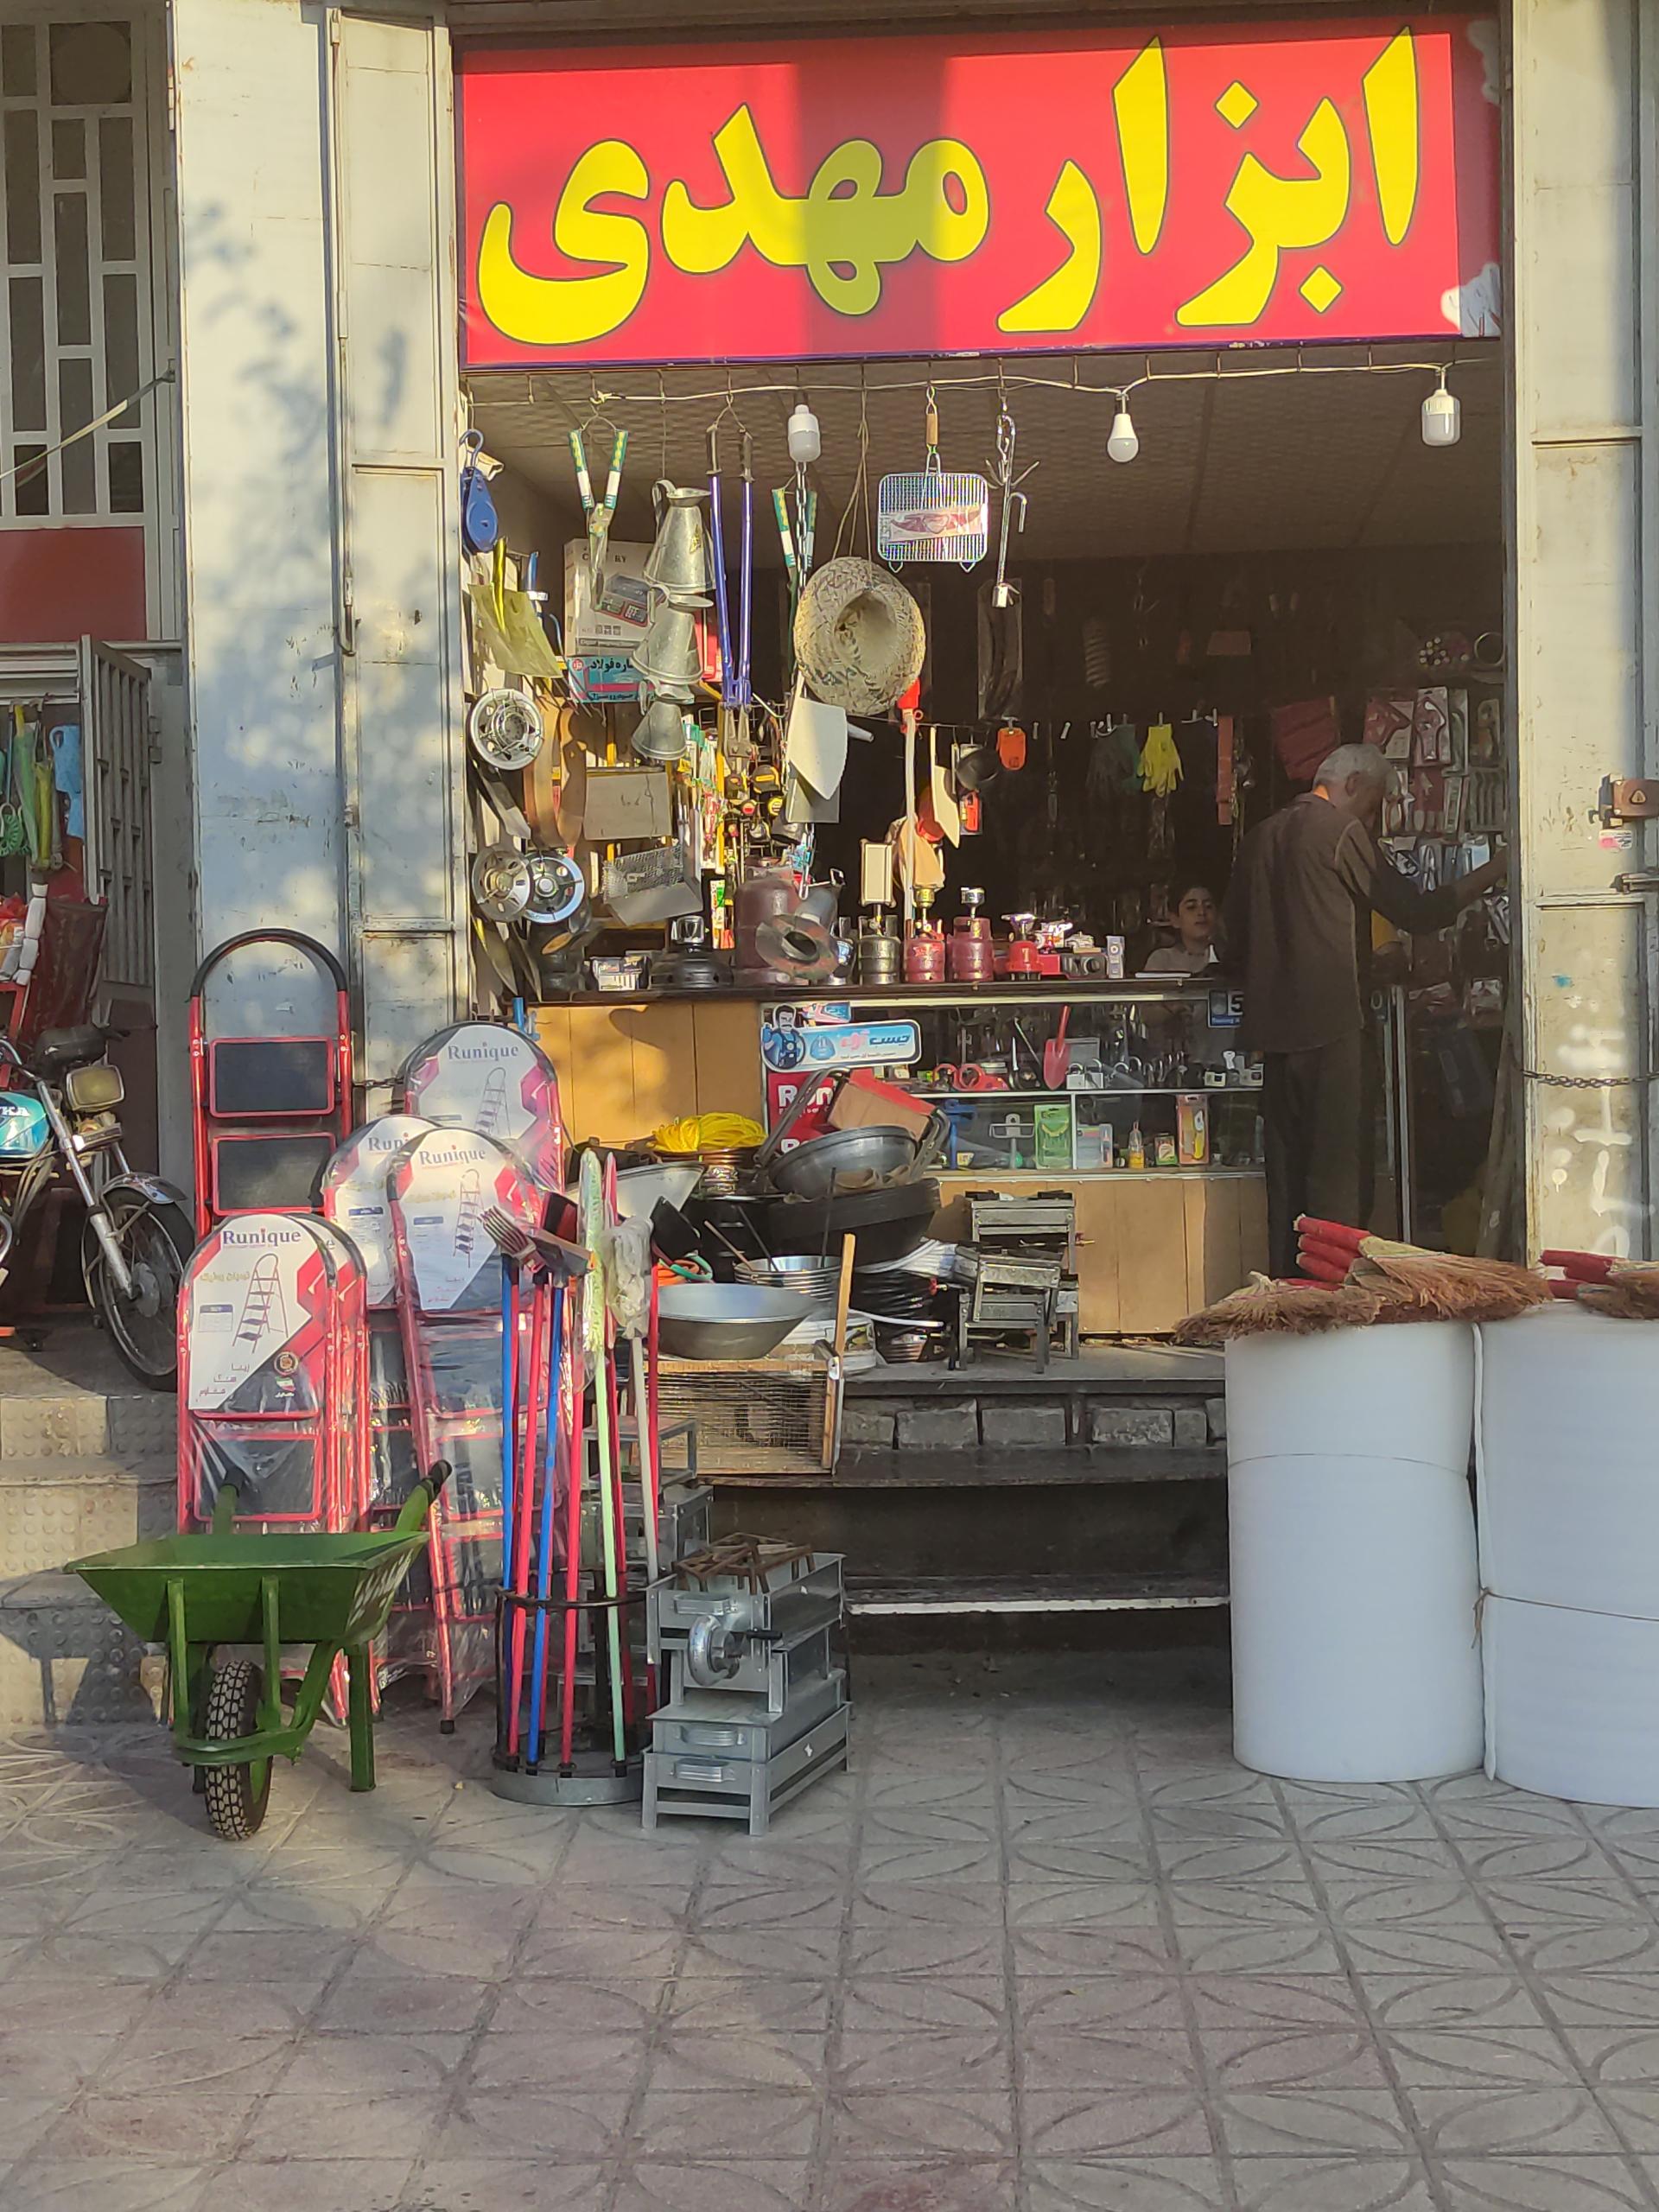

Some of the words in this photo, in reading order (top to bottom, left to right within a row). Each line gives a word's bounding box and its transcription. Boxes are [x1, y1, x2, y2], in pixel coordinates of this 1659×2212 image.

[995, 25, 1420, 334] ابزار
[476, 103, 991, 346] مهدی
[590, 658, 614, 673] فولاد
[448, 1041, 518, 1061] Runique
[419, 1145, 486, 1166] Runique
[222, 1228, 302, 1248] Runique
